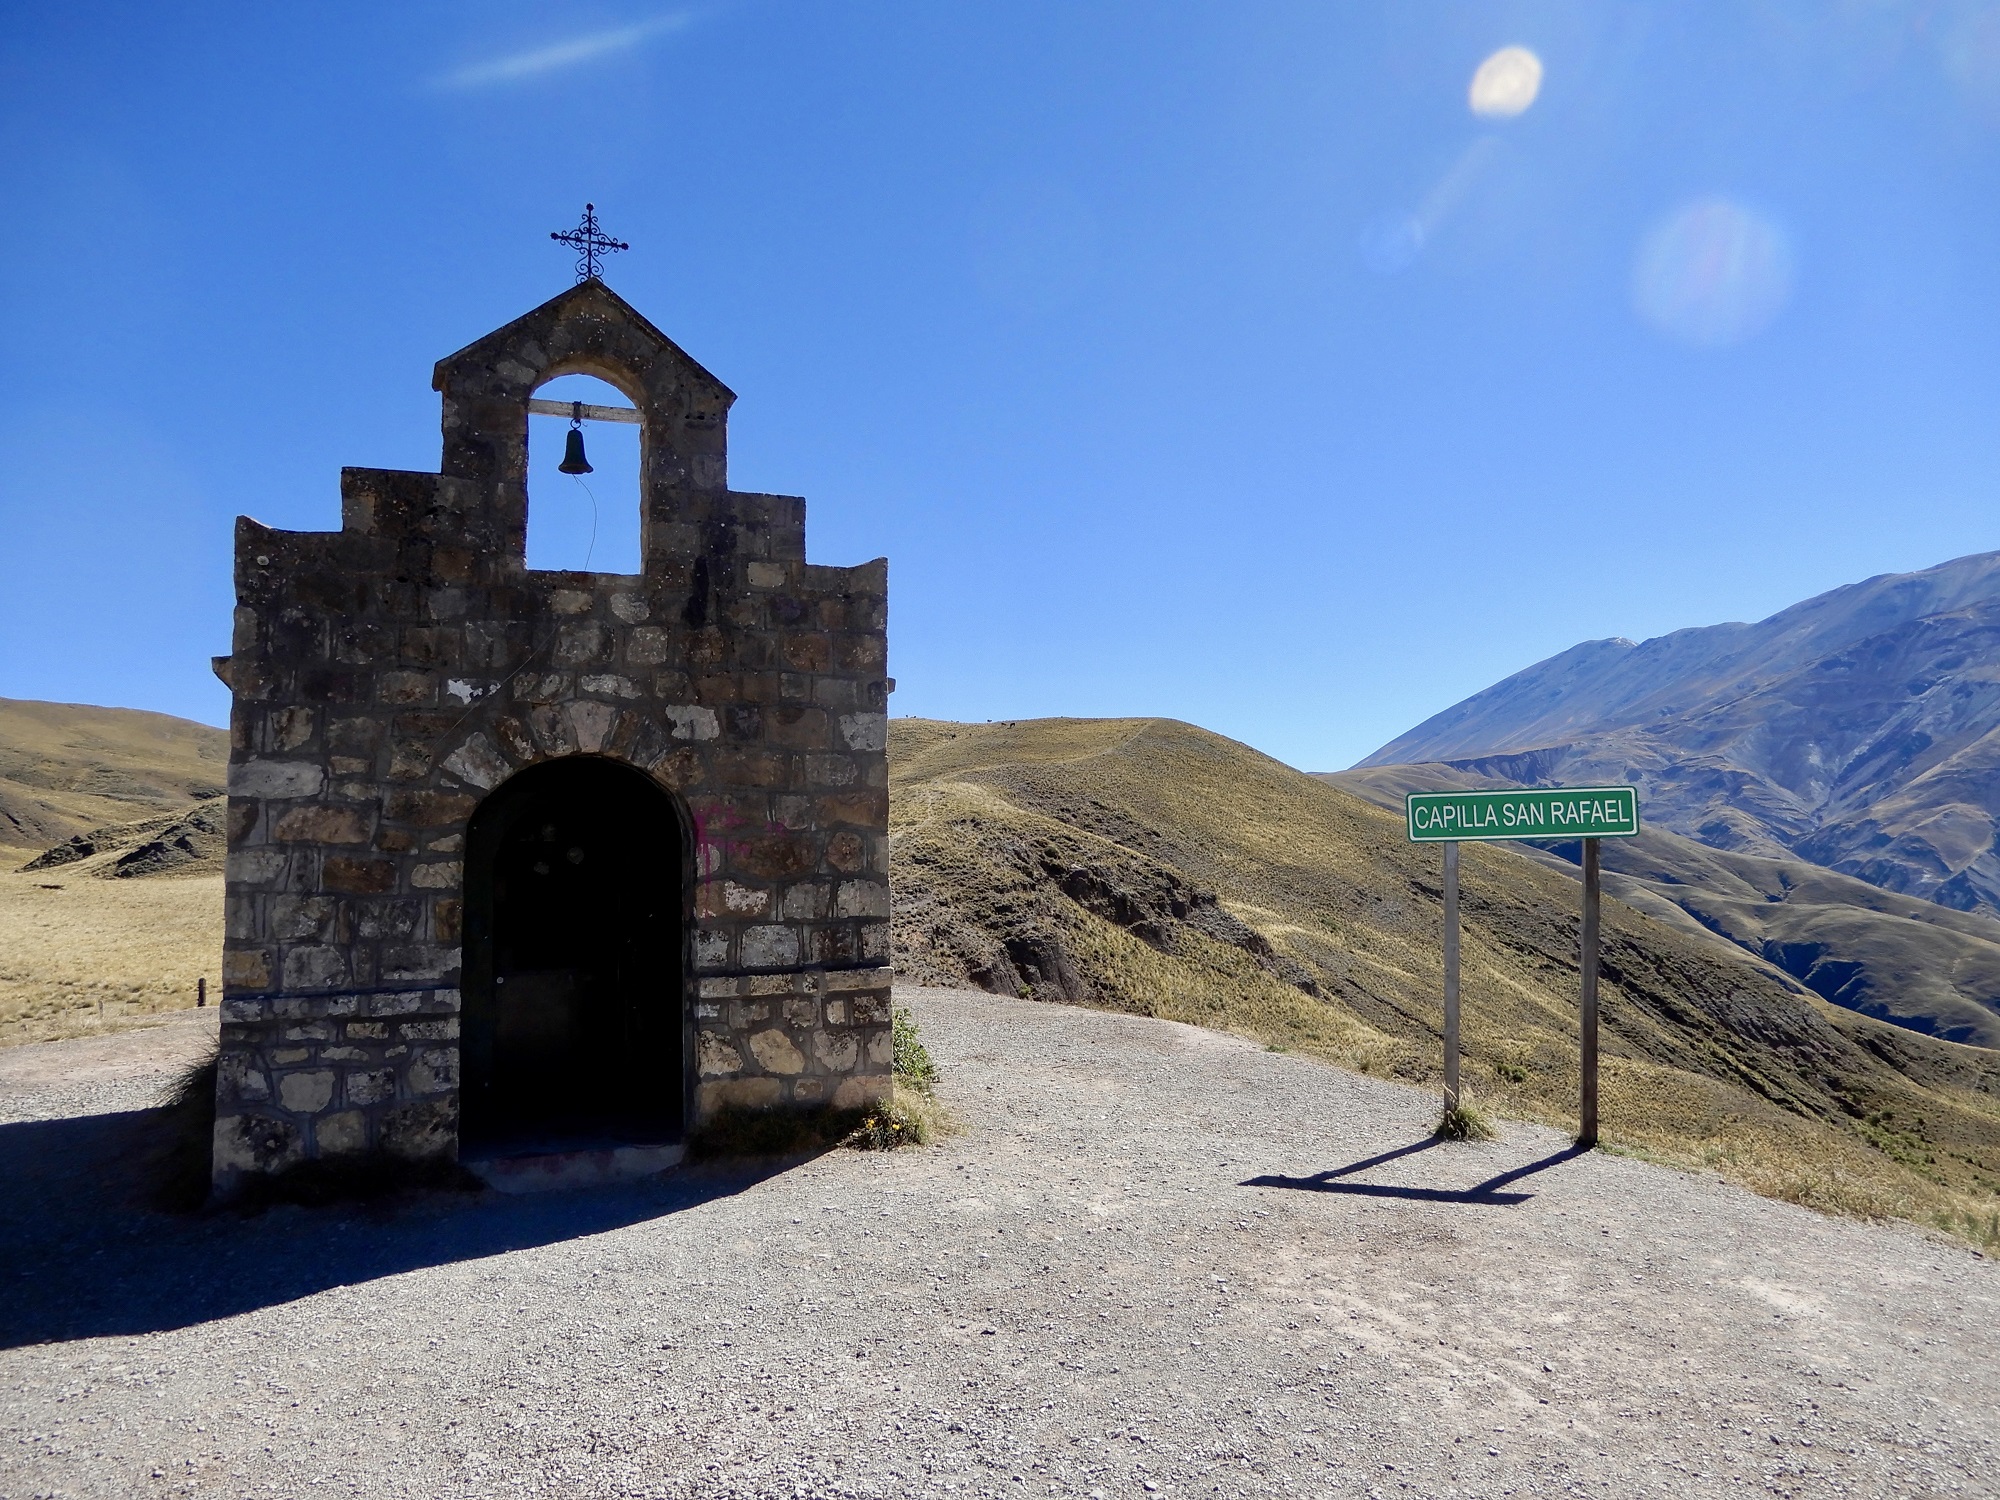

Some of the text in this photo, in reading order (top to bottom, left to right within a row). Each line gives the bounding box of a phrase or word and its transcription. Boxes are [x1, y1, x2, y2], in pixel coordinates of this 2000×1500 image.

[1414, 799, 1630, 829] CAPILLA SAN RAFAEL
